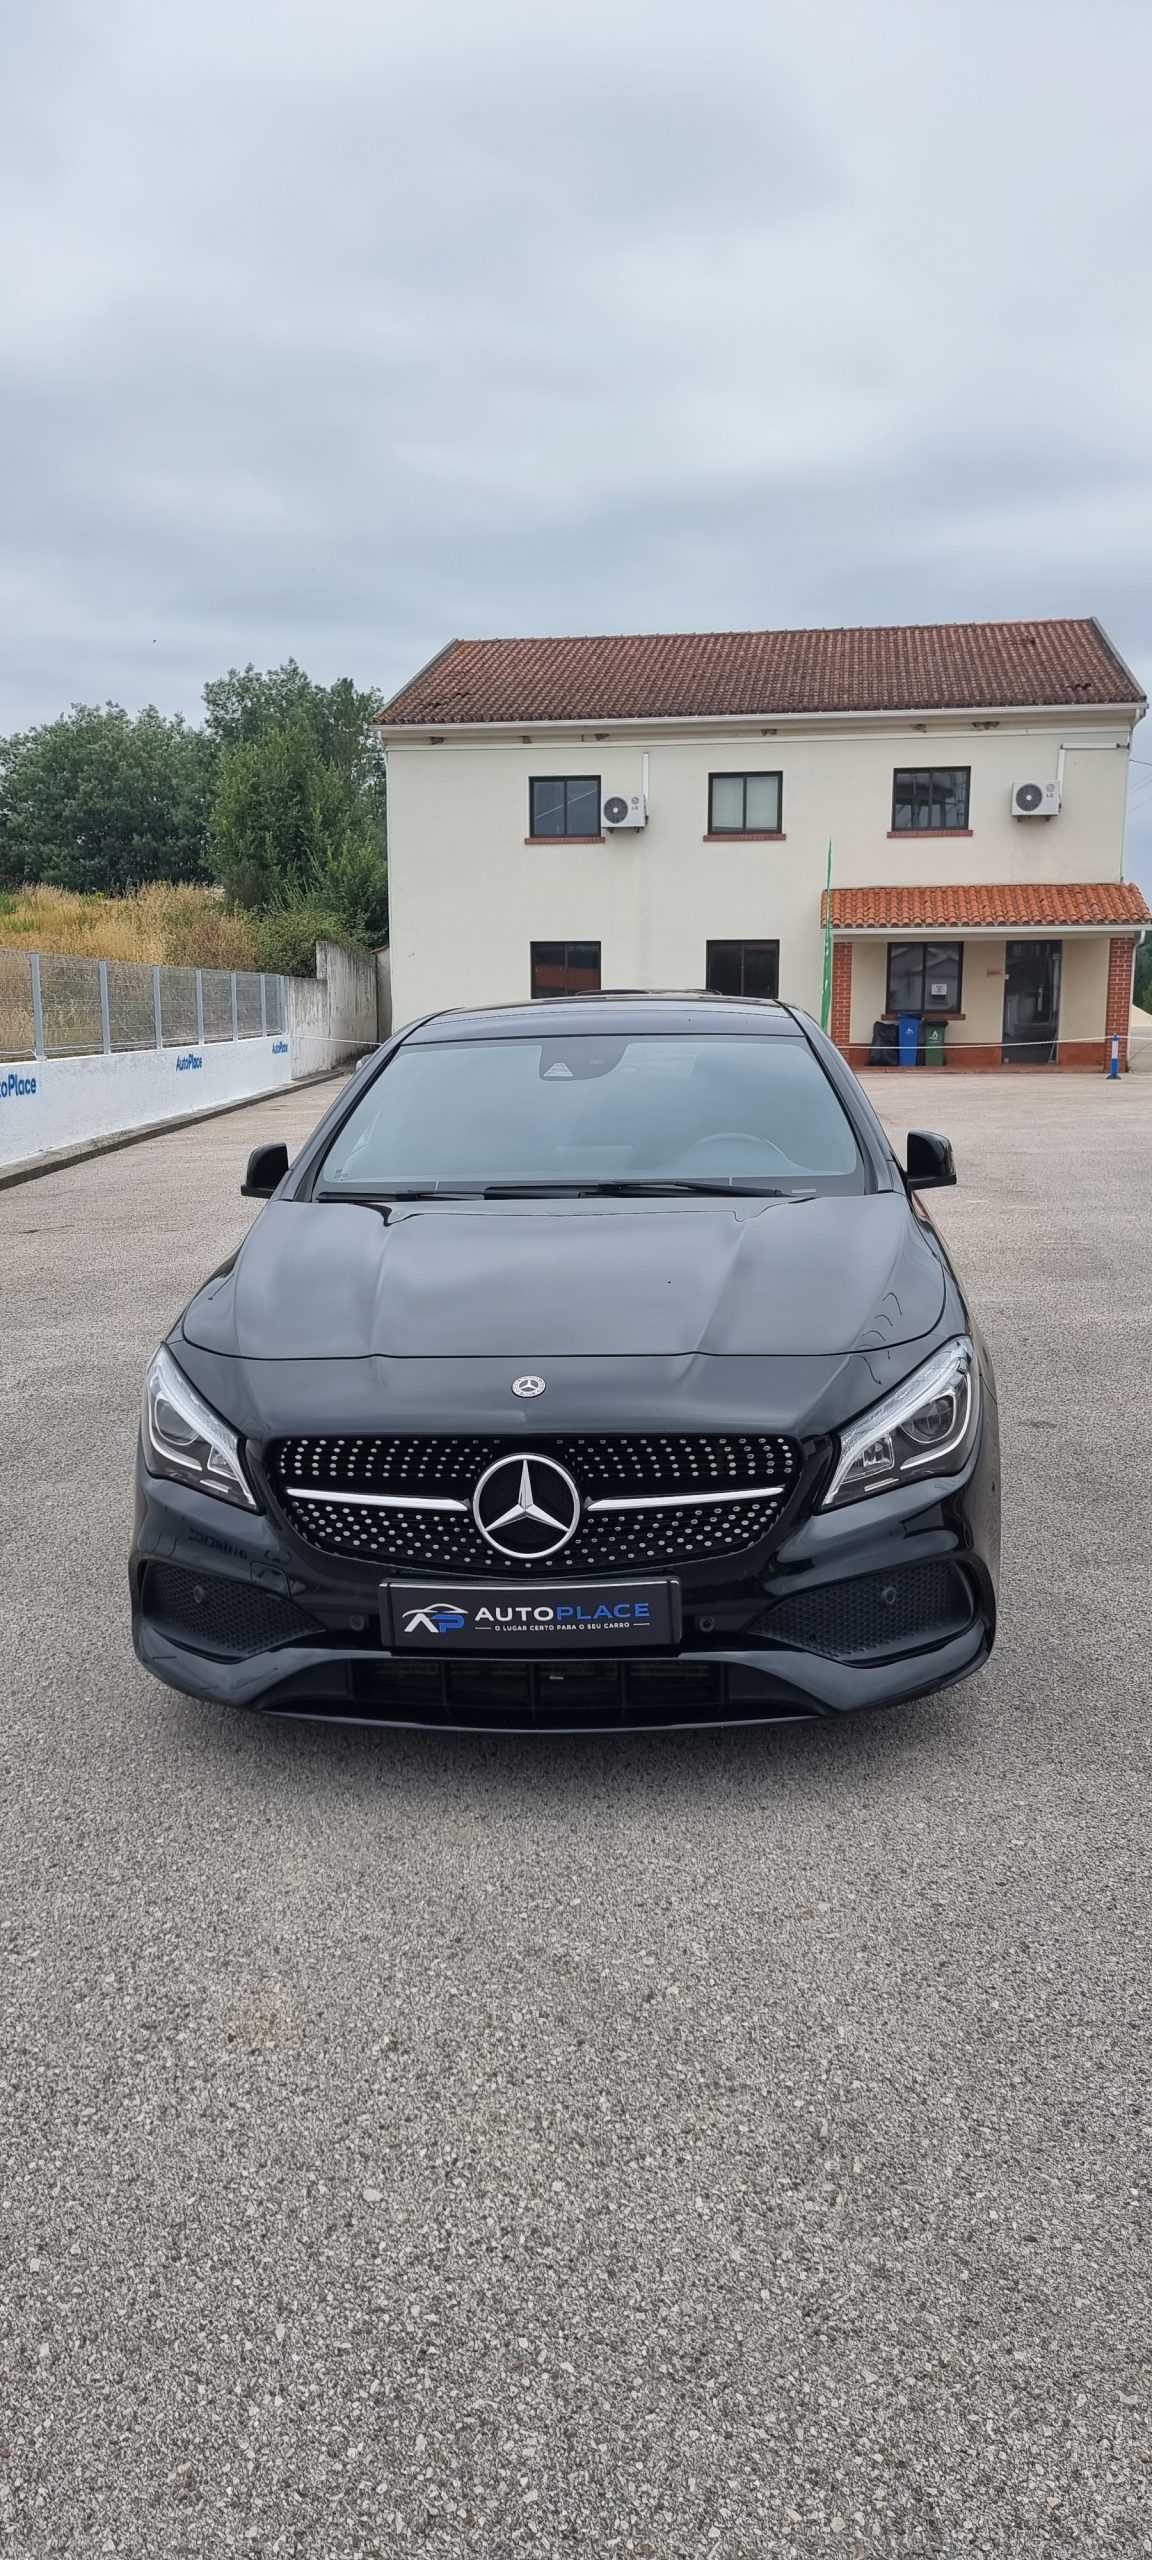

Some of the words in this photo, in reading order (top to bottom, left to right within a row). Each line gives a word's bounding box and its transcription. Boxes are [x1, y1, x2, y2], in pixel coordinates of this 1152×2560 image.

[176, 1054, 203, 1071] AutoPlace
[474, 1603, 650, 1621] AUTOPLACE
[494, 1624, 501, 1632] O
[502, 1624, 528, 1632] LUGAR
[529, 1624, 554, 1632] CERTO
[587, 1622, 602, 1630] SEU
[603, 1621, 630, 1629] CARRO
